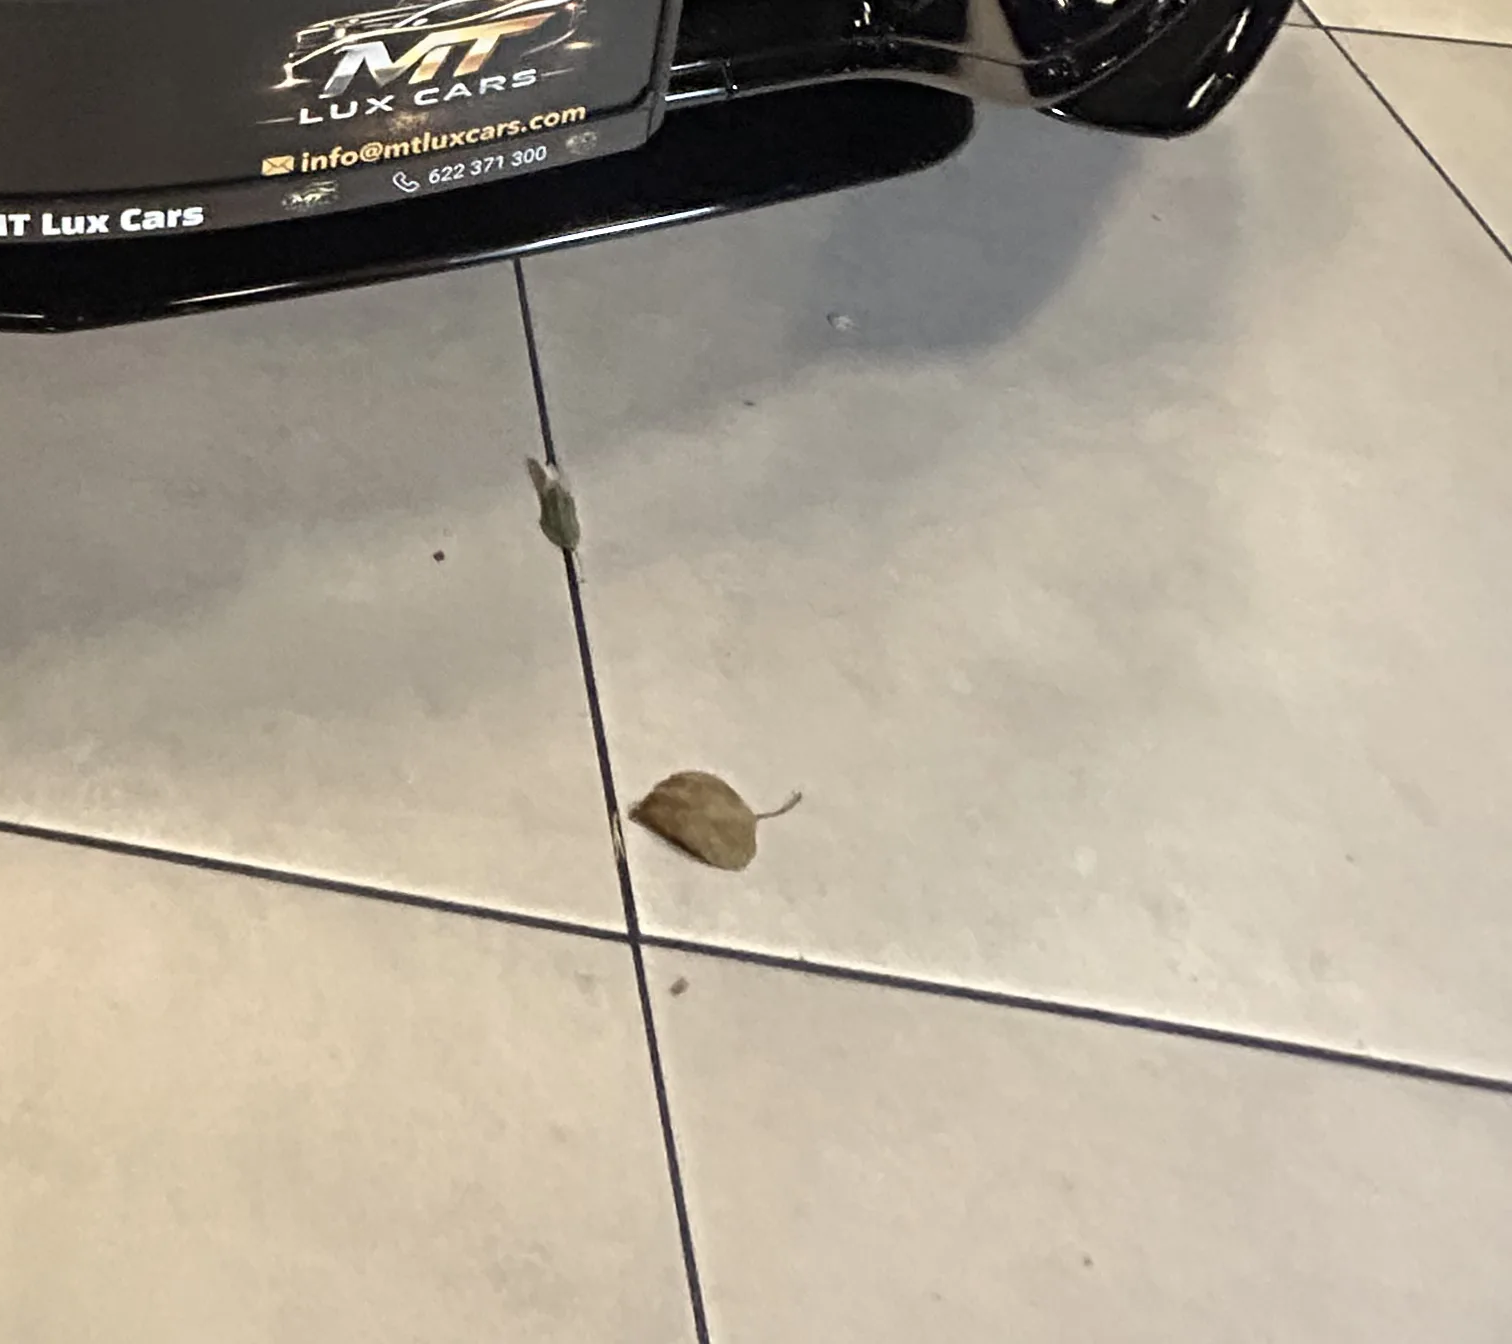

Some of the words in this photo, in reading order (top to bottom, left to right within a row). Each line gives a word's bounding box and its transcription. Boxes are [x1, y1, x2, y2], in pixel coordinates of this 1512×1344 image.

[319, 13, 558, 98] MT
[300, 95, 396, 125] LUX
[414, 68, 537, 106] CARS
[301, 106, 586, 173] info@mtluxcars.com
[428, 162, 465, 185] 622
[471, 157, 504, 178] 371
[511, 145, 547, 167] 300
[42, 211, 109, 237] Lux
[120, 203, 205, 232] Cars
